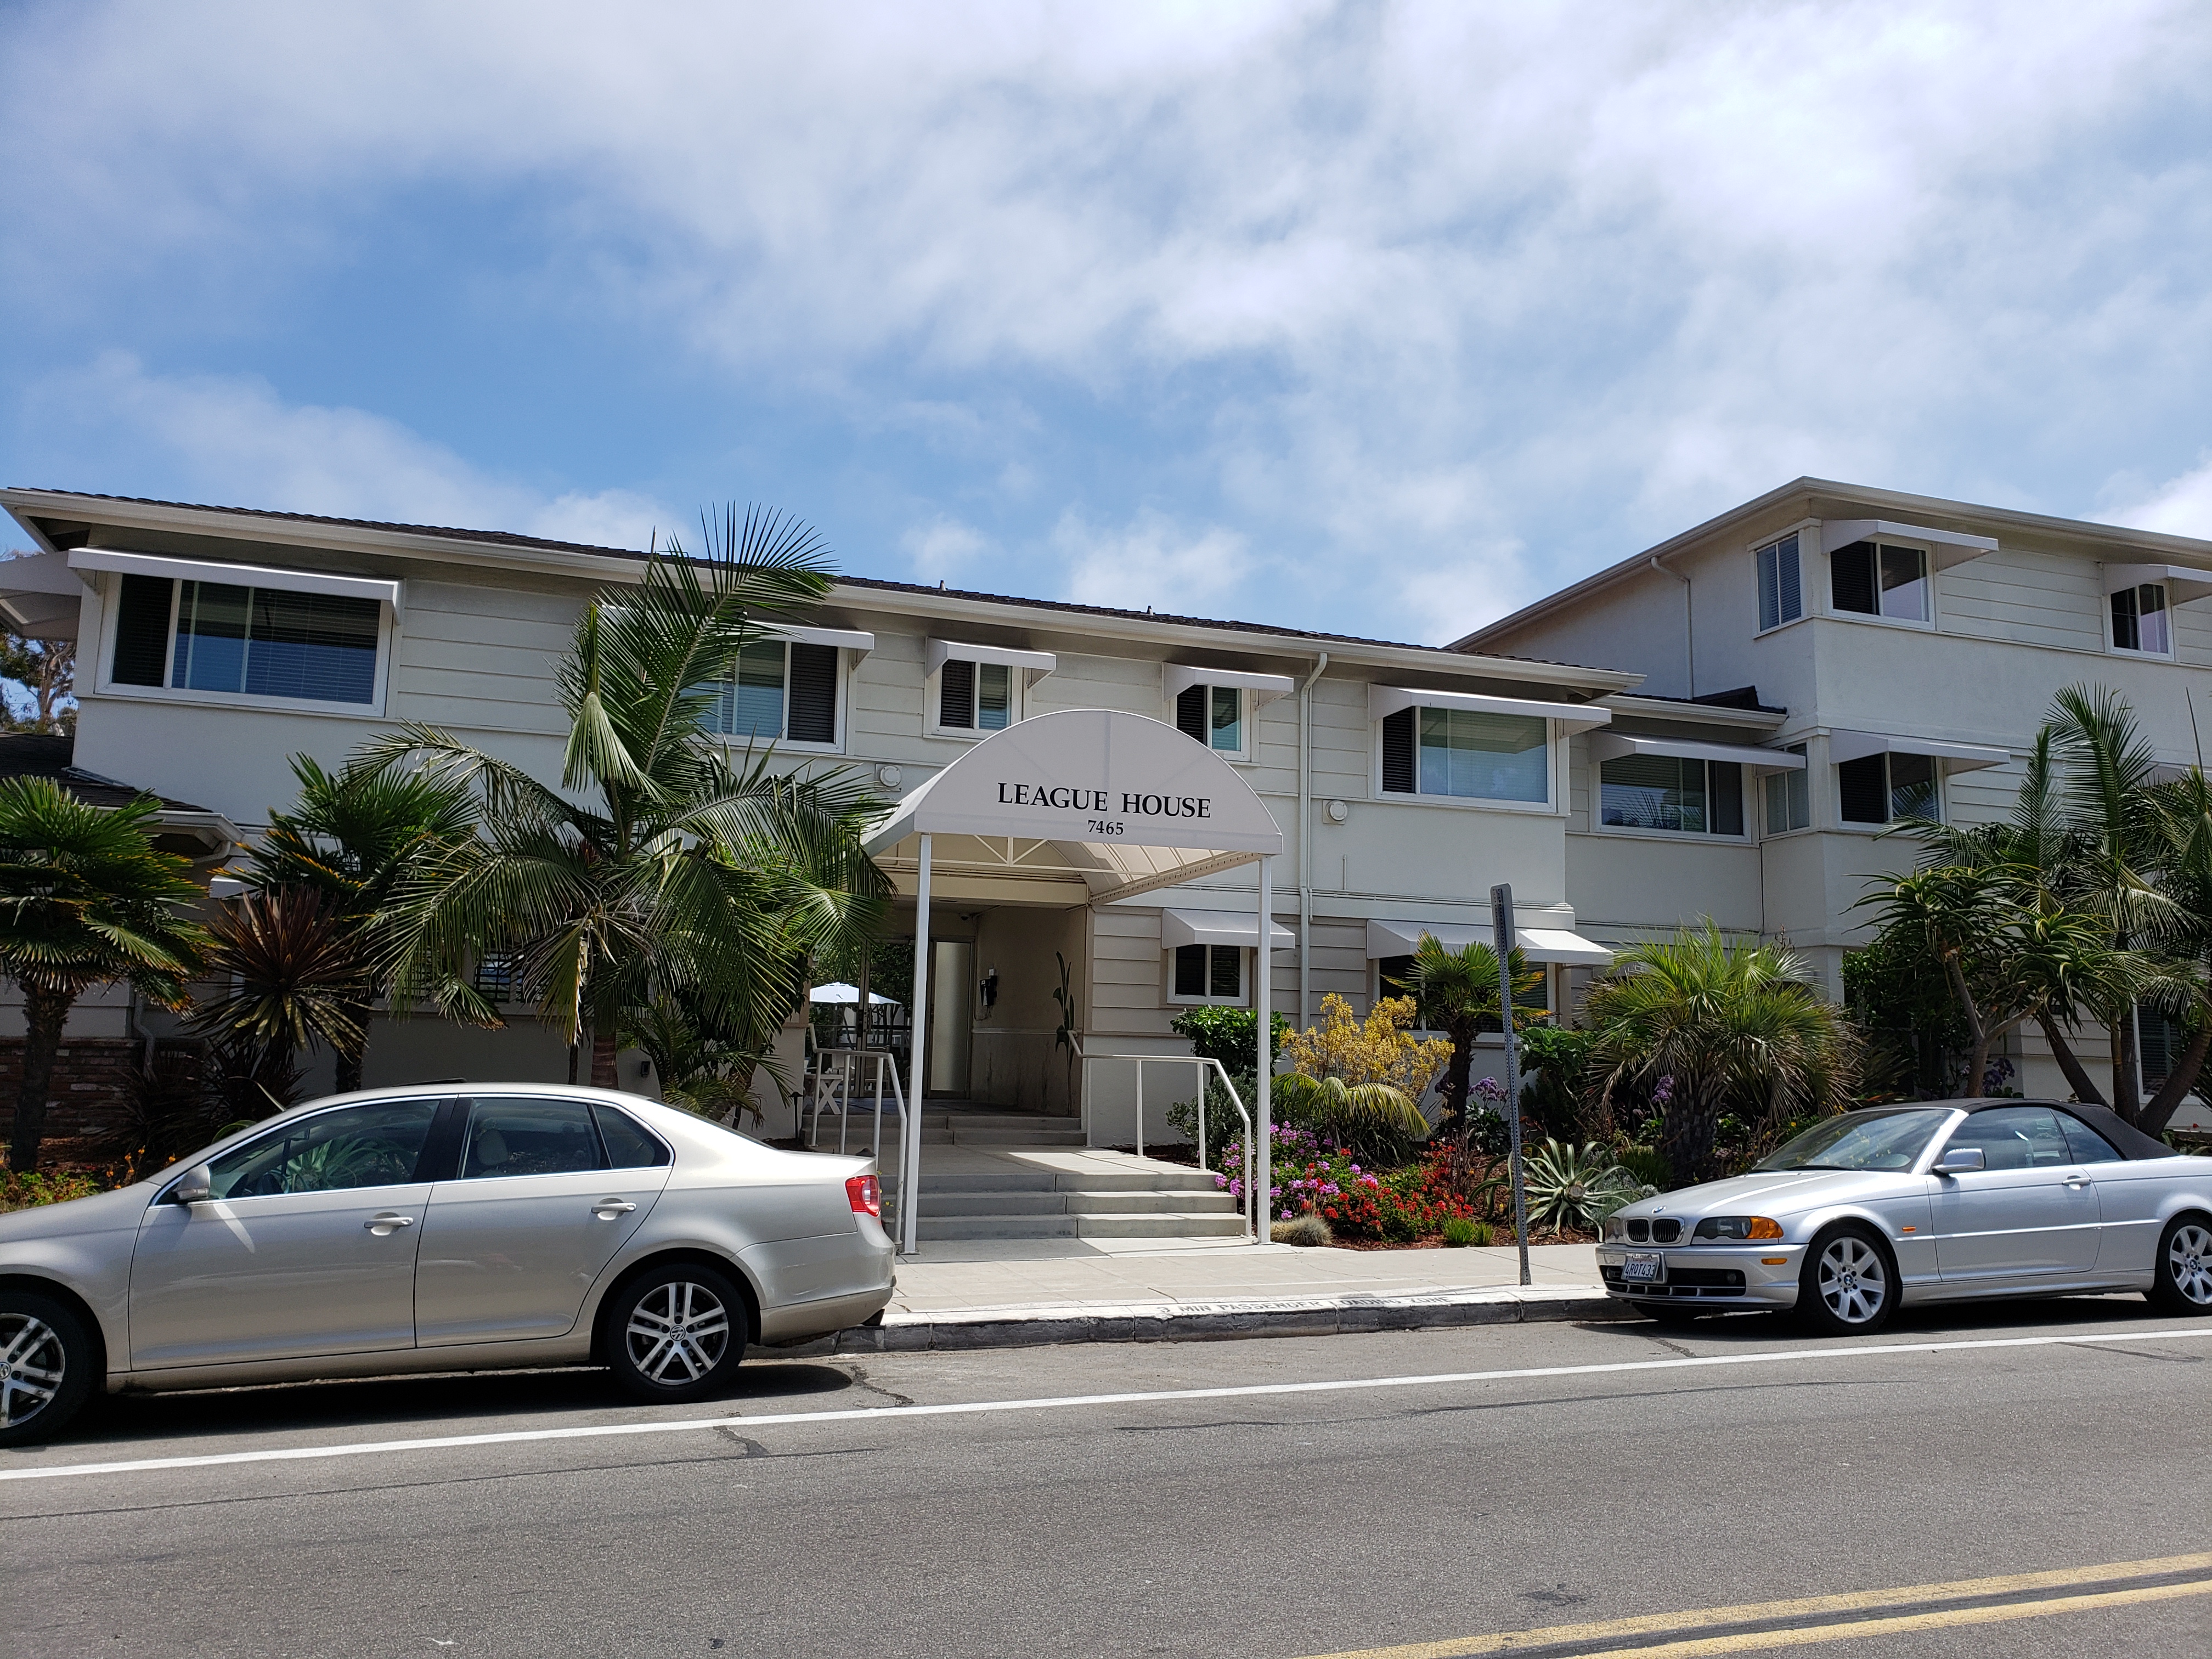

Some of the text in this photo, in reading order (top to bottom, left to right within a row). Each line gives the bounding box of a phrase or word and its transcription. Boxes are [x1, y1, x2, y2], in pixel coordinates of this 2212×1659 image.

[998, 782, 1211, 818] LEAGUE HOUSE
[1088, 820, 1124, 835] 7465
[1218, 1301, 1323, 1310] PASSENGER
